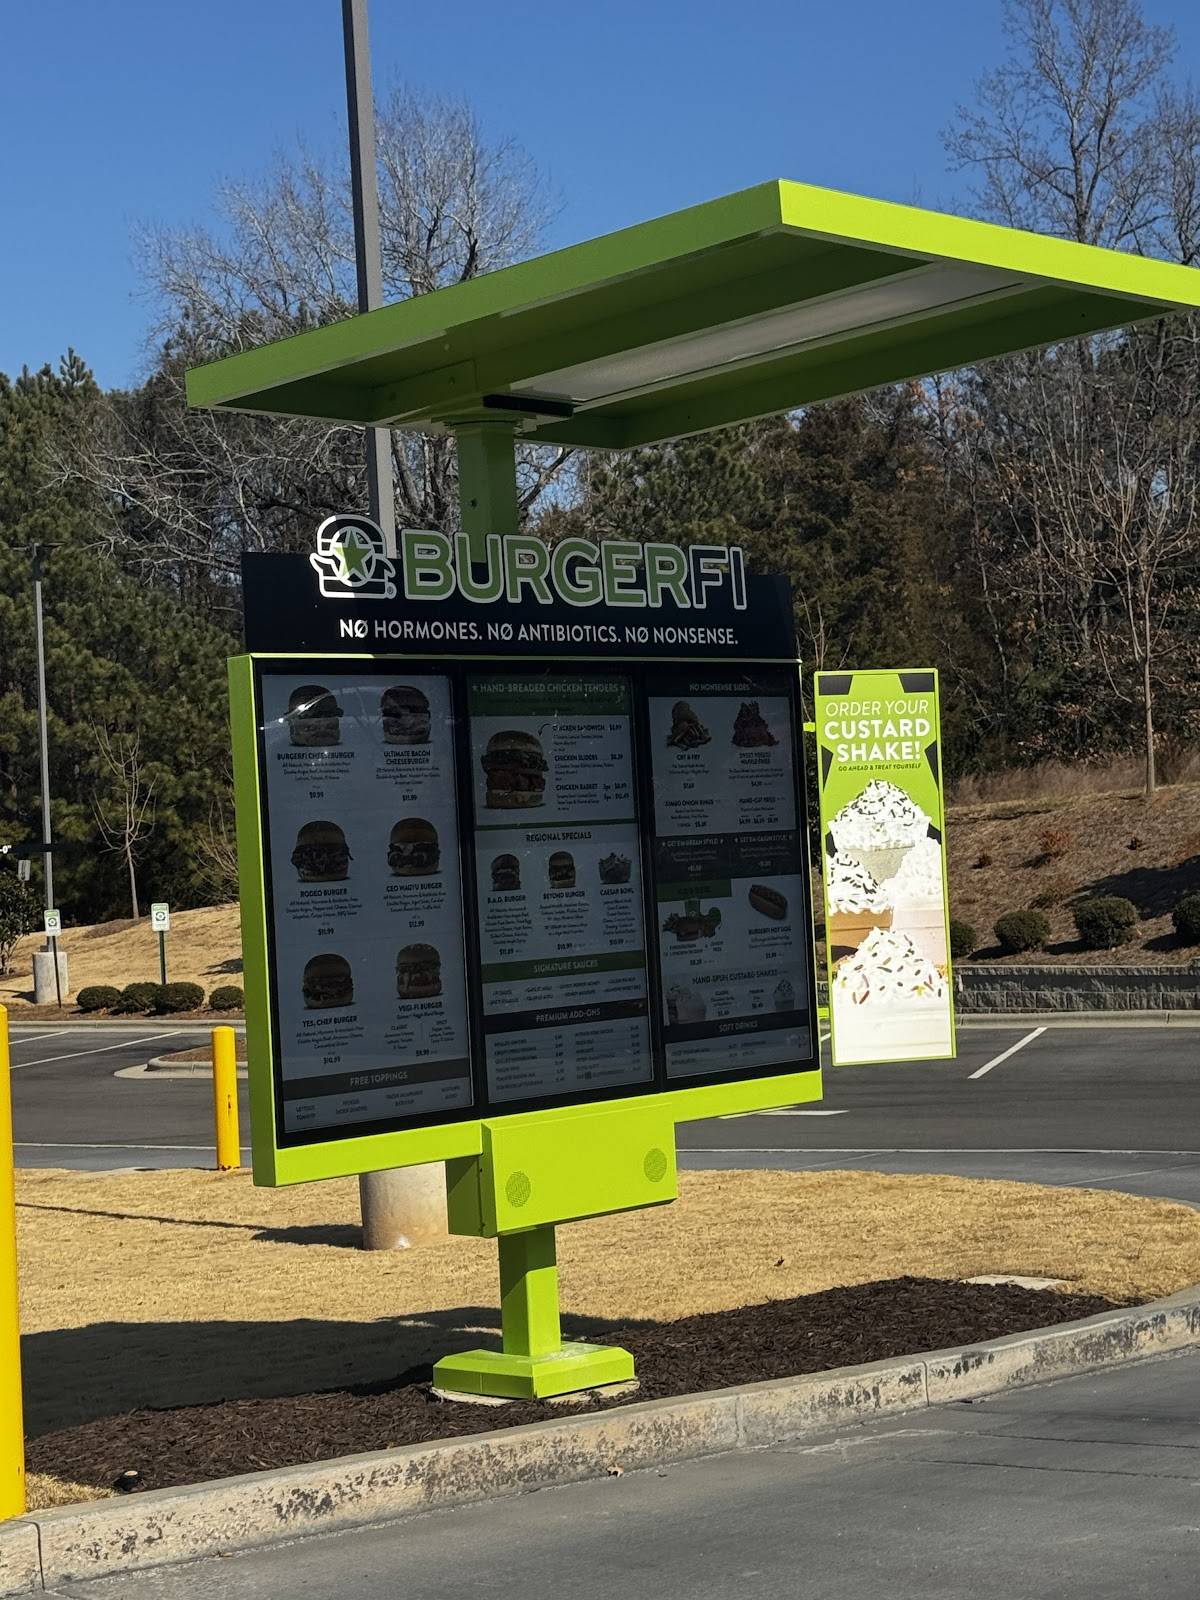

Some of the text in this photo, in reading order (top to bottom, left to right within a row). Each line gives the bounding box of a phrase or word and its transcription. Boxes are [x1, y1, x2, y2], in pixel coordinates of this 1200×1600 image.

[401, 529, 747, 611] BURGERFI
[374, 620, 483, 640] HORMONES.
[518, 624, 621, 643] ANTIBIOTICS.
[653, 627, 738, 645] NONSENSE.
[547, 683, 582, 693] CHICKEN
[825, 699, 929, 717] ORDER YOUR
[824, 718, 930, 740] CUSTARD
[837, 741, 921, 762] SHAKE!
[526, 831, 591, 842] REGIONAL SPECIALS
[323, 888, 347, 896] BURGER
[334, 1015, 357, 1024] BURGER
[536, 1012, 569, 1023] PREMIUM
[350, 1071, 409, 1087] FREE TOPPINGS
